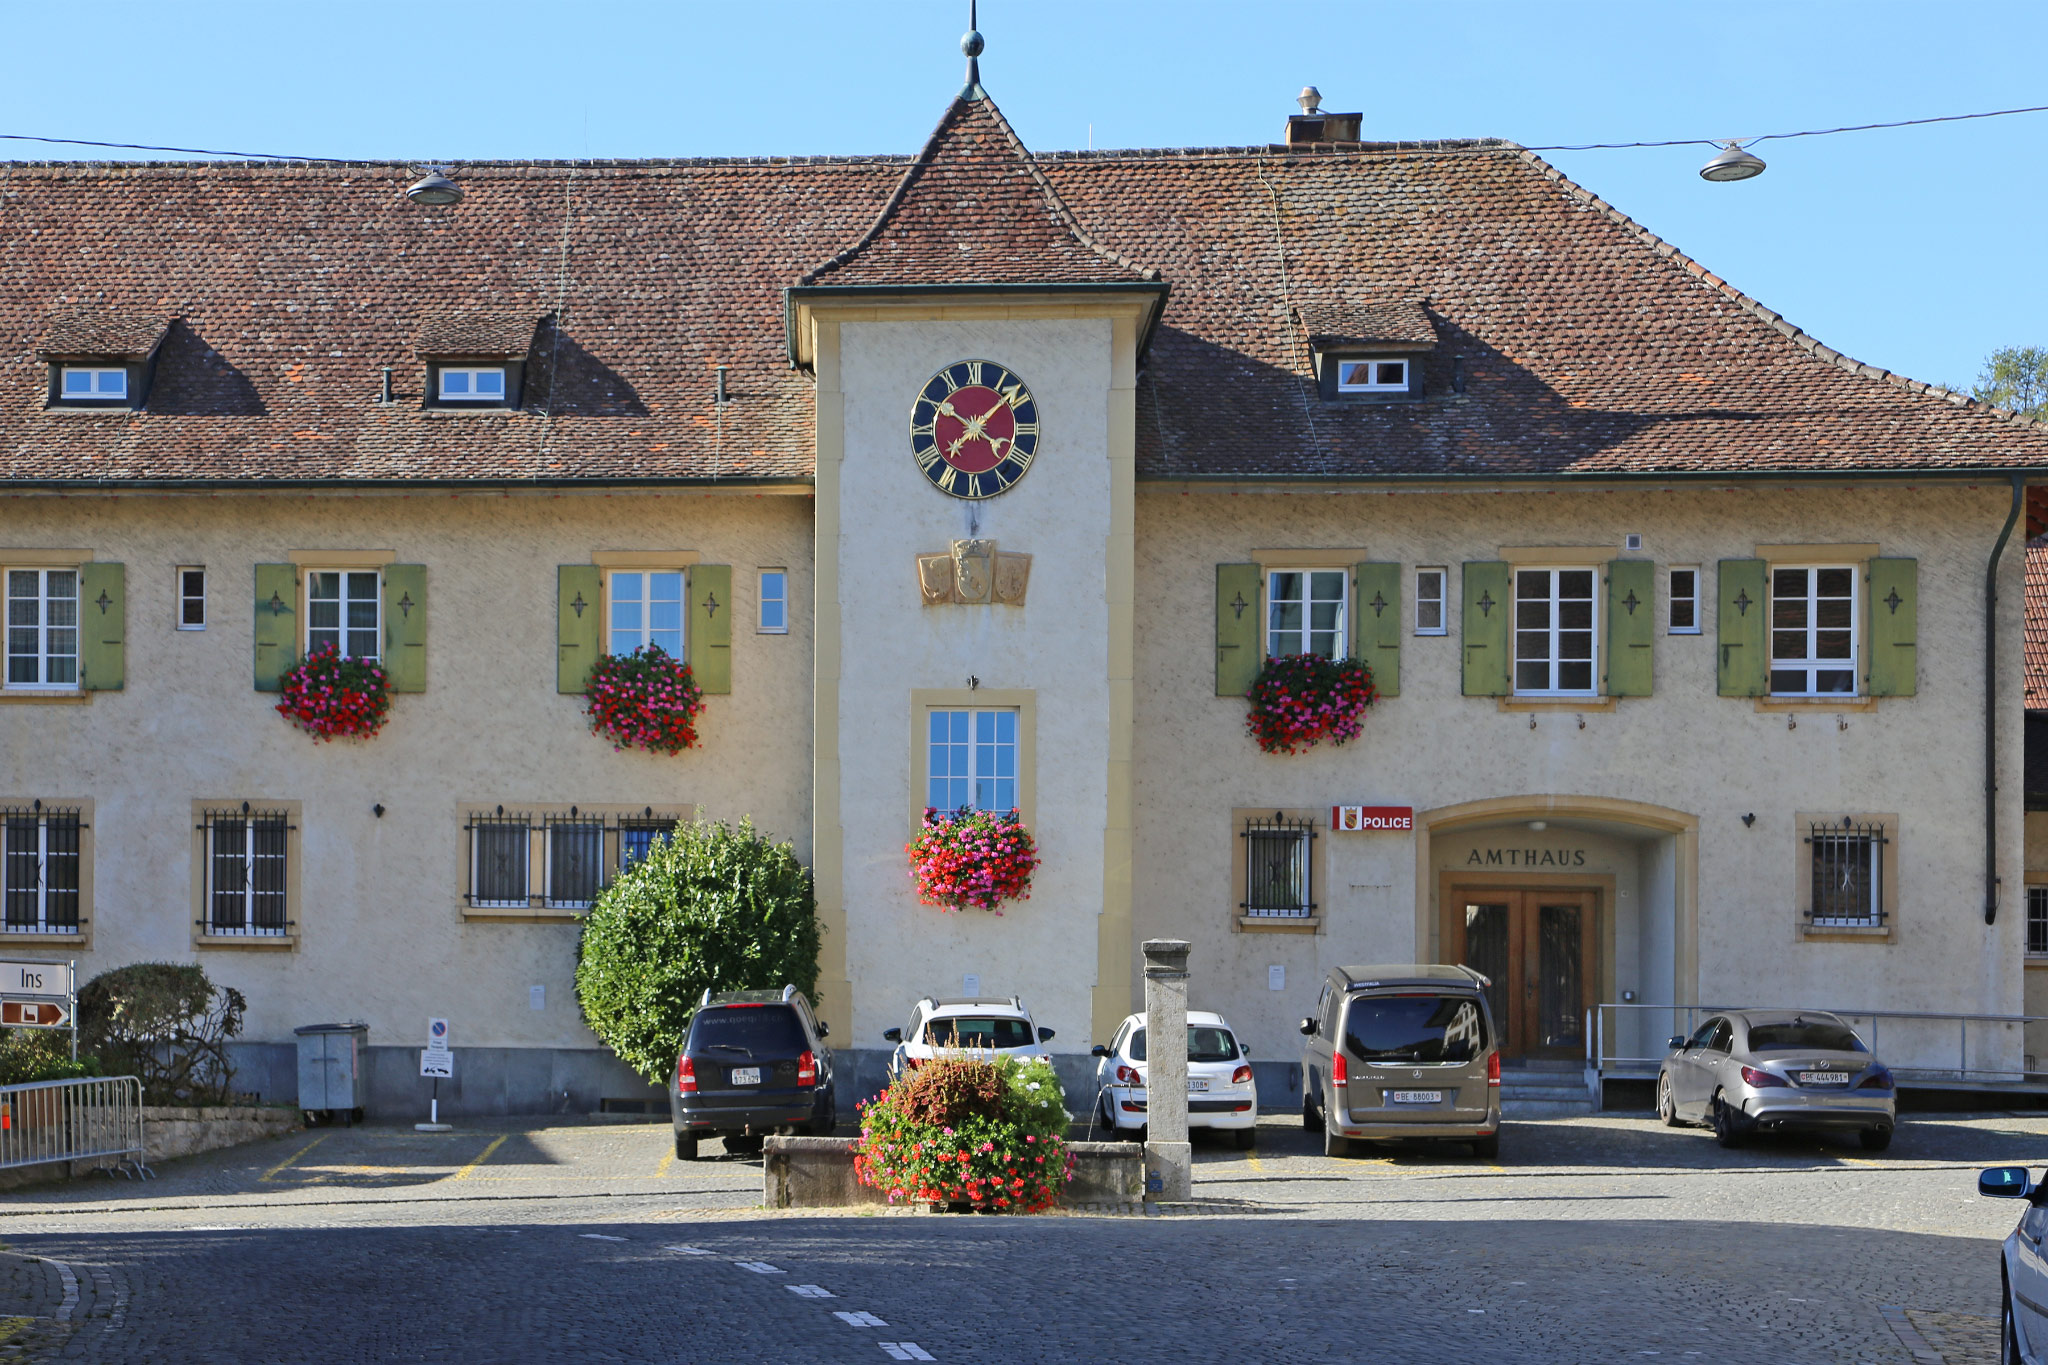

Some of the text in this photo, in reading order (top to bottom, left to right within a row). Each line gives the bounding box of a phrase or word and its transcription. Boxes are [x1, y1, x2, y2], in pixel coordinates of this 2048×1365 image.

[939, 368, 959, 393] XI
[966, 362, 982, 385] XII
[994, 369, 1008, 391] I
[920, 392, 941, 411] X
[912, 422, 933, 437] IX
[1016, 422, 1037, 436] III
[1363, 817, 1411, 829] POLICE
[1467, 848, 1585, 866] AMTHAUS
[21, 967, 42, 988] Ins
[1401, 1092, 1409, 1101] BE
